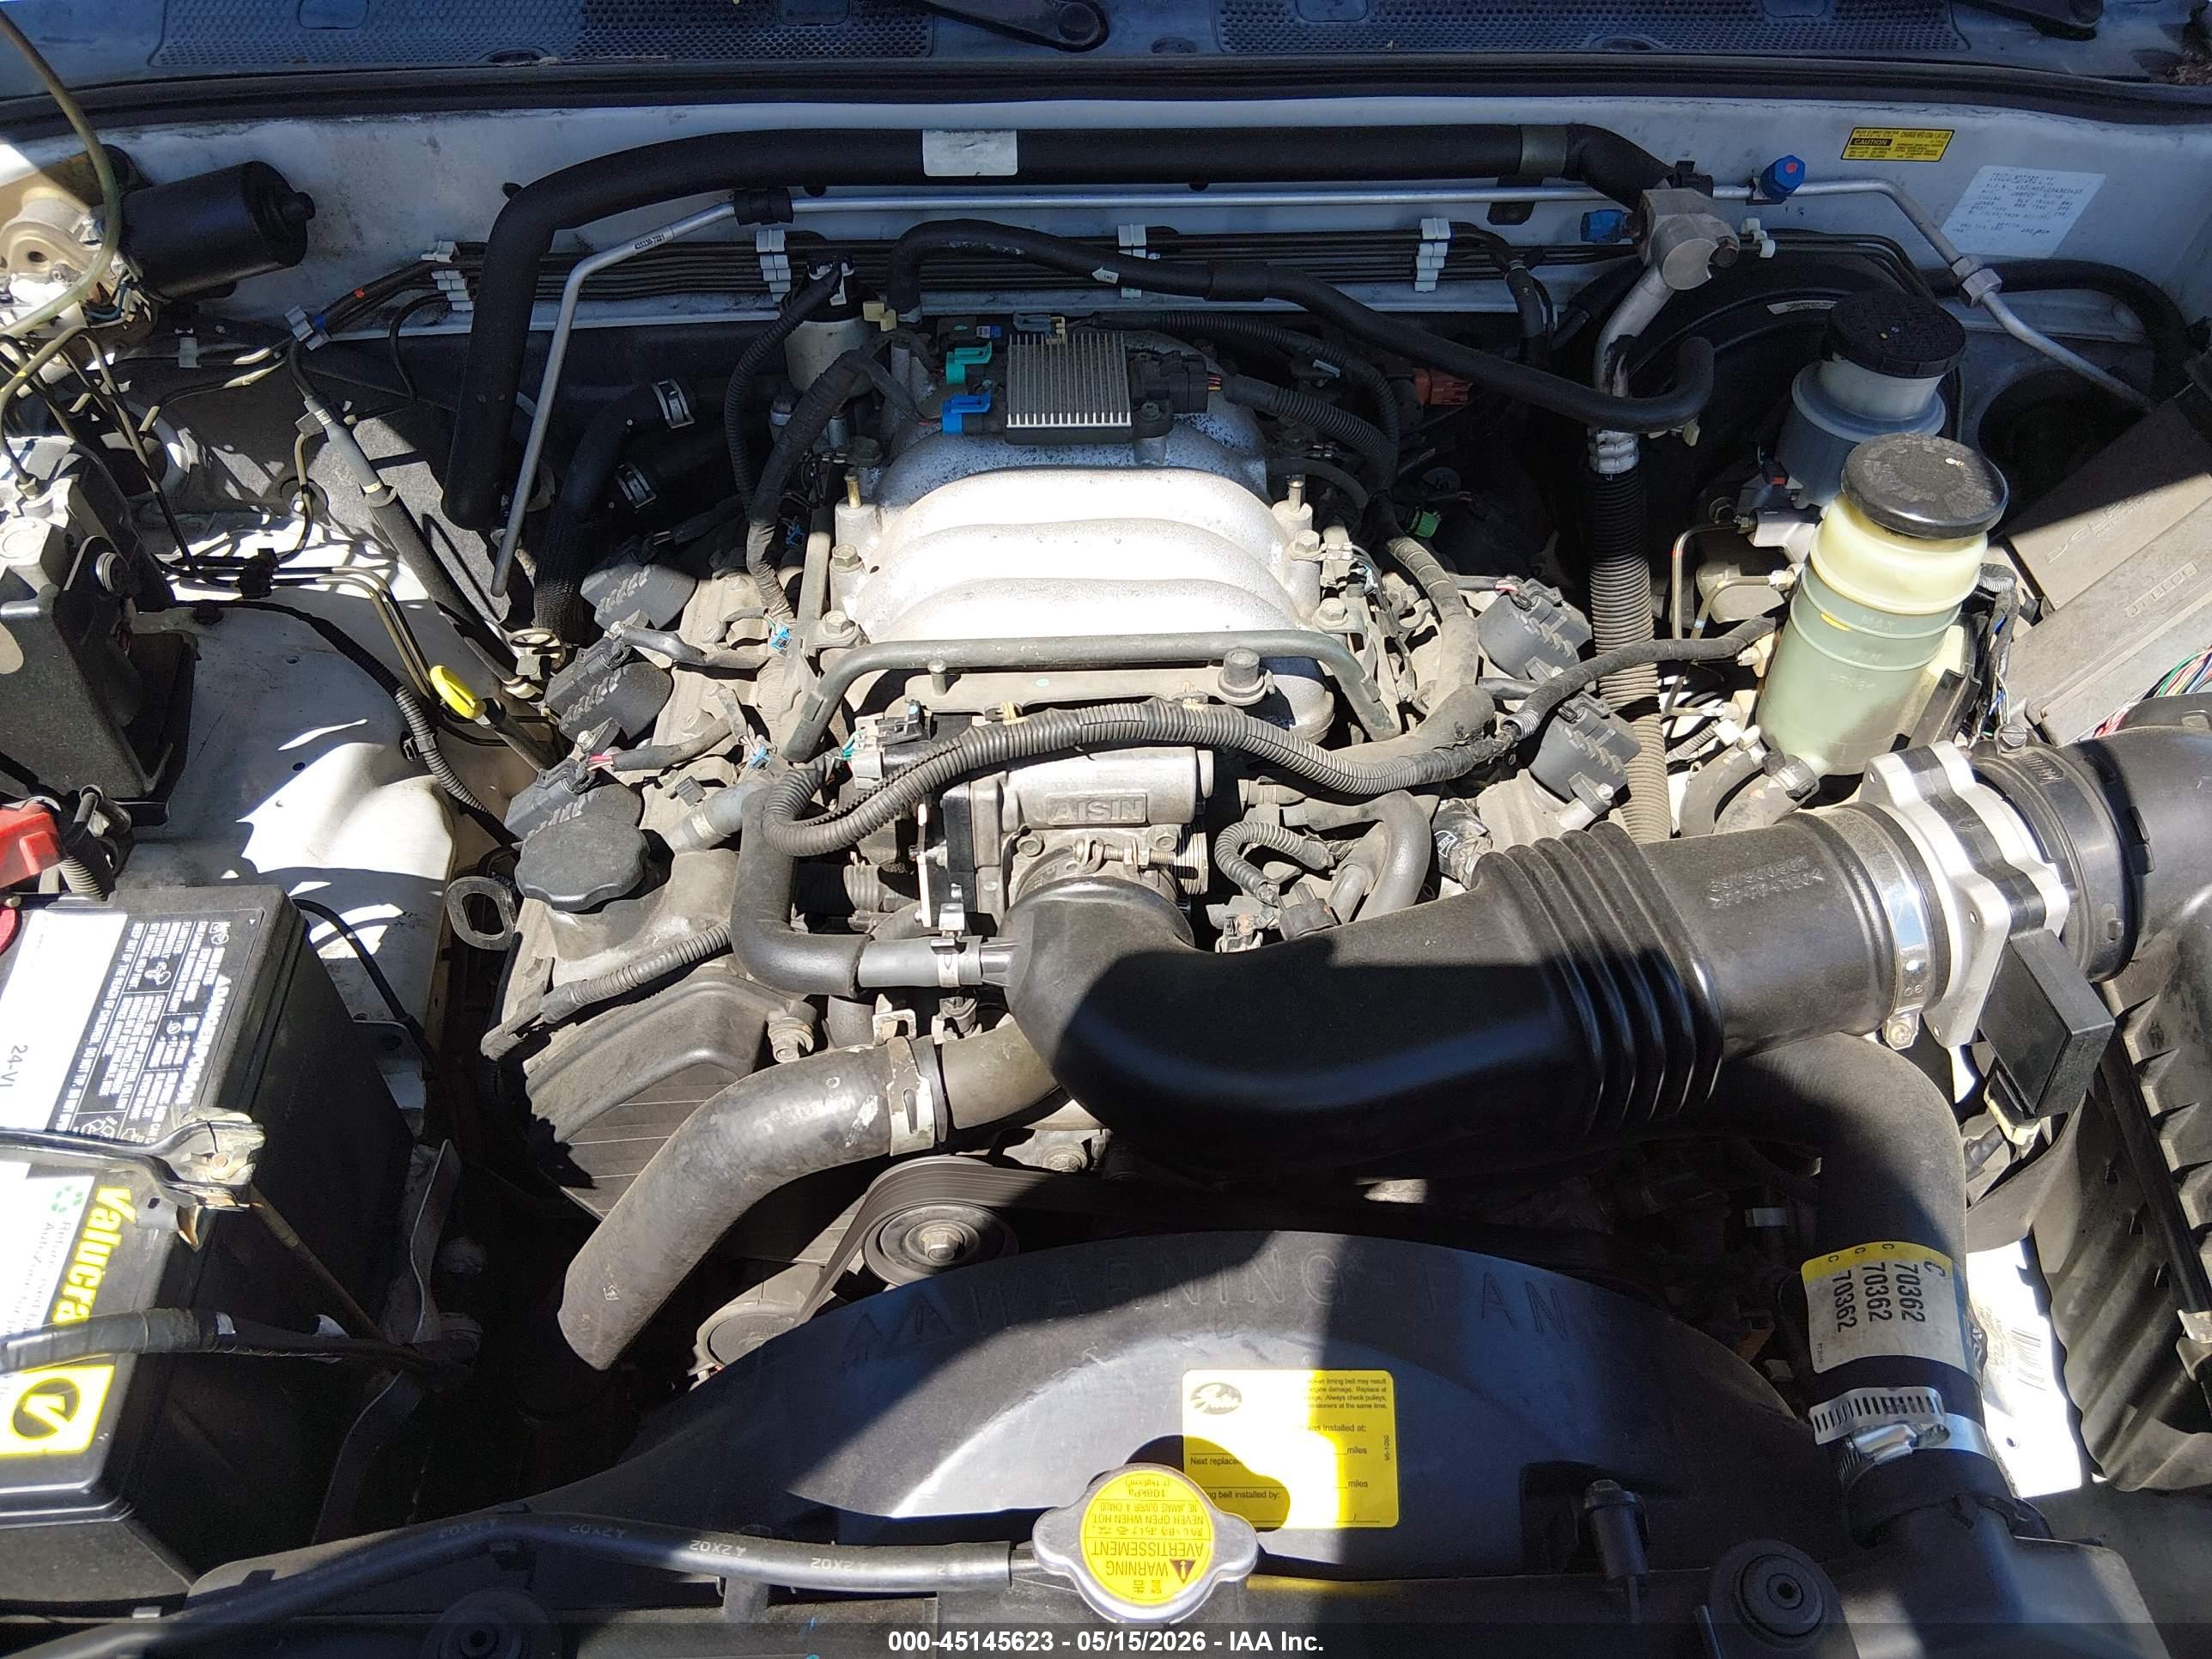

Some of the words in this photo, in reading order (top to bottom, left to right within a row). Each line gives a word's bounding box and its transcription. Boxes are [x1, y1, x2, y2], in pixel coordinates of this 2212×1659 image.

[1051, 799, 1143, 822] AISIN
[53, 1187, 136, 1328] Valucra
[969, 1248, 1346, 1331] WARNING
[1863, 1262, 1893, 1322] 70362
[1894, 1263, 1926, 1322] 70362
[1832, 1270, 1857, 1333] 70362
[1210, 1457, 1243, 1467] replace
[1129, 1489, 1165, 1498] 108kPa
[1269, 1491, 1280, 1500] by:
[1134, 1503, 1158, 1512] OUVRIR
[1162, 1504, 1184, 1512] JAMAIS
[1190, 1504, 1197, 1512] NE
[1115, 1515, 1142, 1523] WHEN
[1146, 1515, 1170, 1523] OPEN
[1173, 1516, 1203, 1524] NEVER
[1091, 1541, 1204, 1556] AVERTISSEMENT
[1106, 1560, 1169, 1577] WARNING
